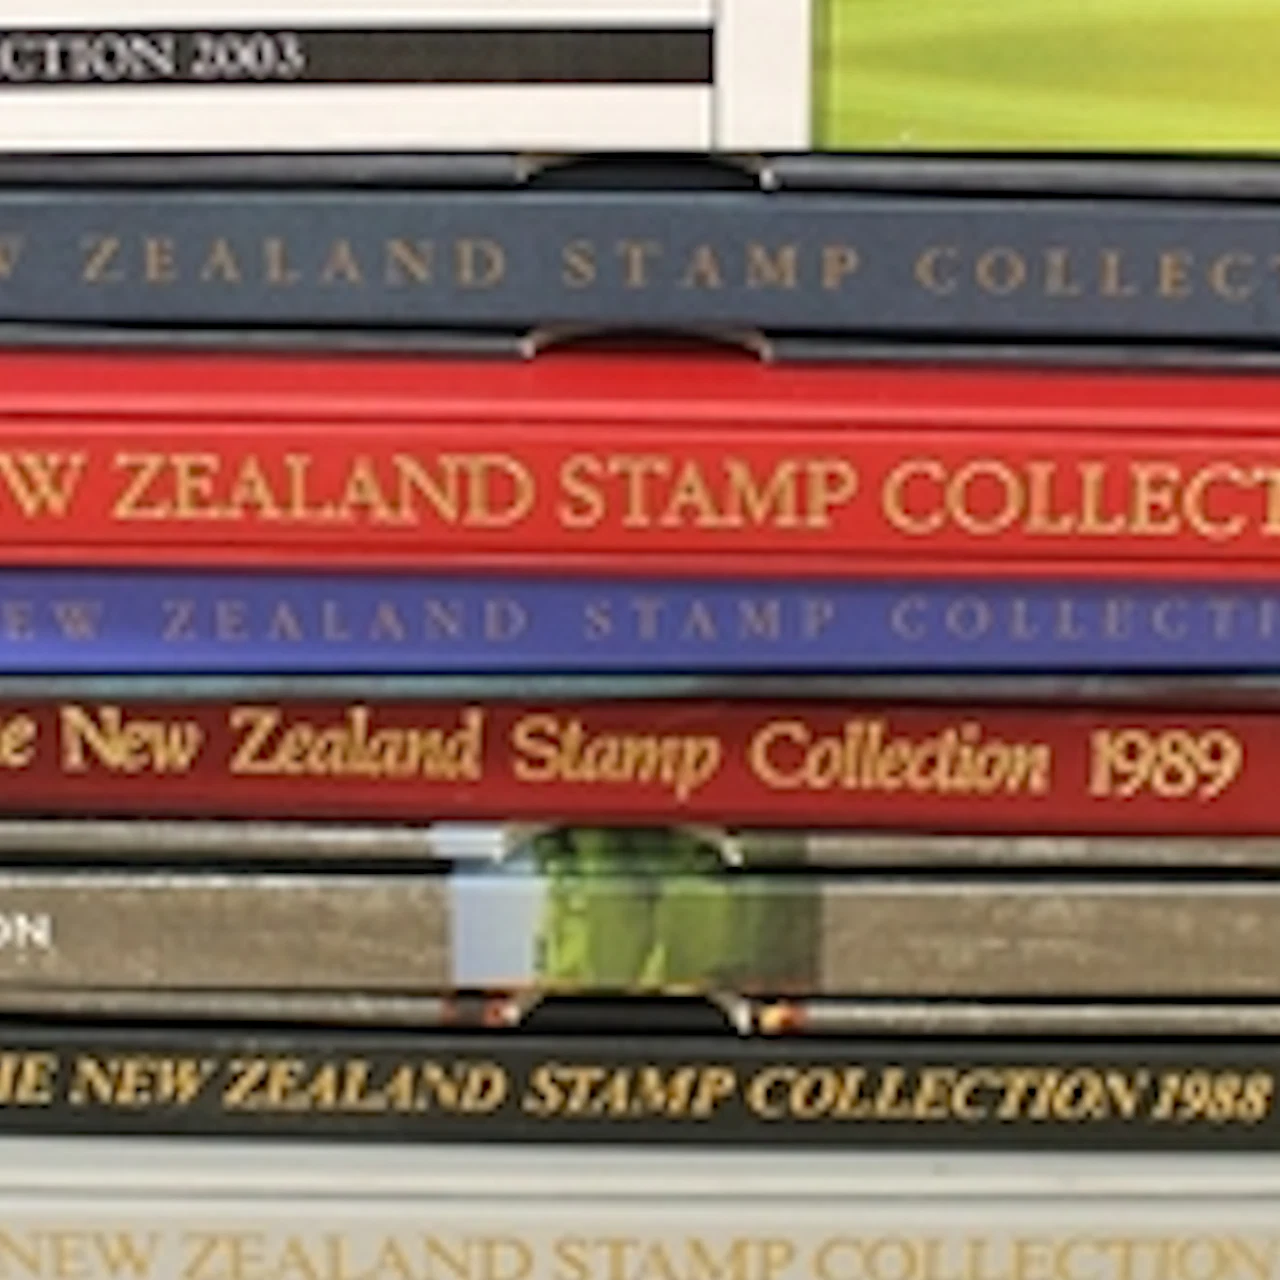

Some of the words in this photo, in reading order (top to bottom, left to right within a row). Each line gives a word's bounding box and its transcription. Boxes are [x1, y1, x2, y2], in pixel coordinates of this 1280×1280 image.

[189, 31, 308, 79] 2003
[80, 235, 507, 287] ZEALAND
[561, 240, 861, 291] STAMP
[112, 452, 535, 525] ZEALAND
[557, 455, 859, 529] STAMP
[161, 598, 524, 644] ZEALAND
[583, 596, 837, 642] STAMP
[59, 706, 203, 773] New
[229, 706, 484, 781] Zealand
[512, 716, 720, 802] Stamp
[749, 720, 1050, 794] Collection
[1087, 729, 1243, 799] 1989
[68, 1053, 216, 1108] NEW
[223, 1057, 507, 1112] ZEALAND
[523, 1065, 737, 1119] STAMP
[746, 1066, 1152, 1122] COLLECTION
[1152, 1070, 1276, 1122] 1988
